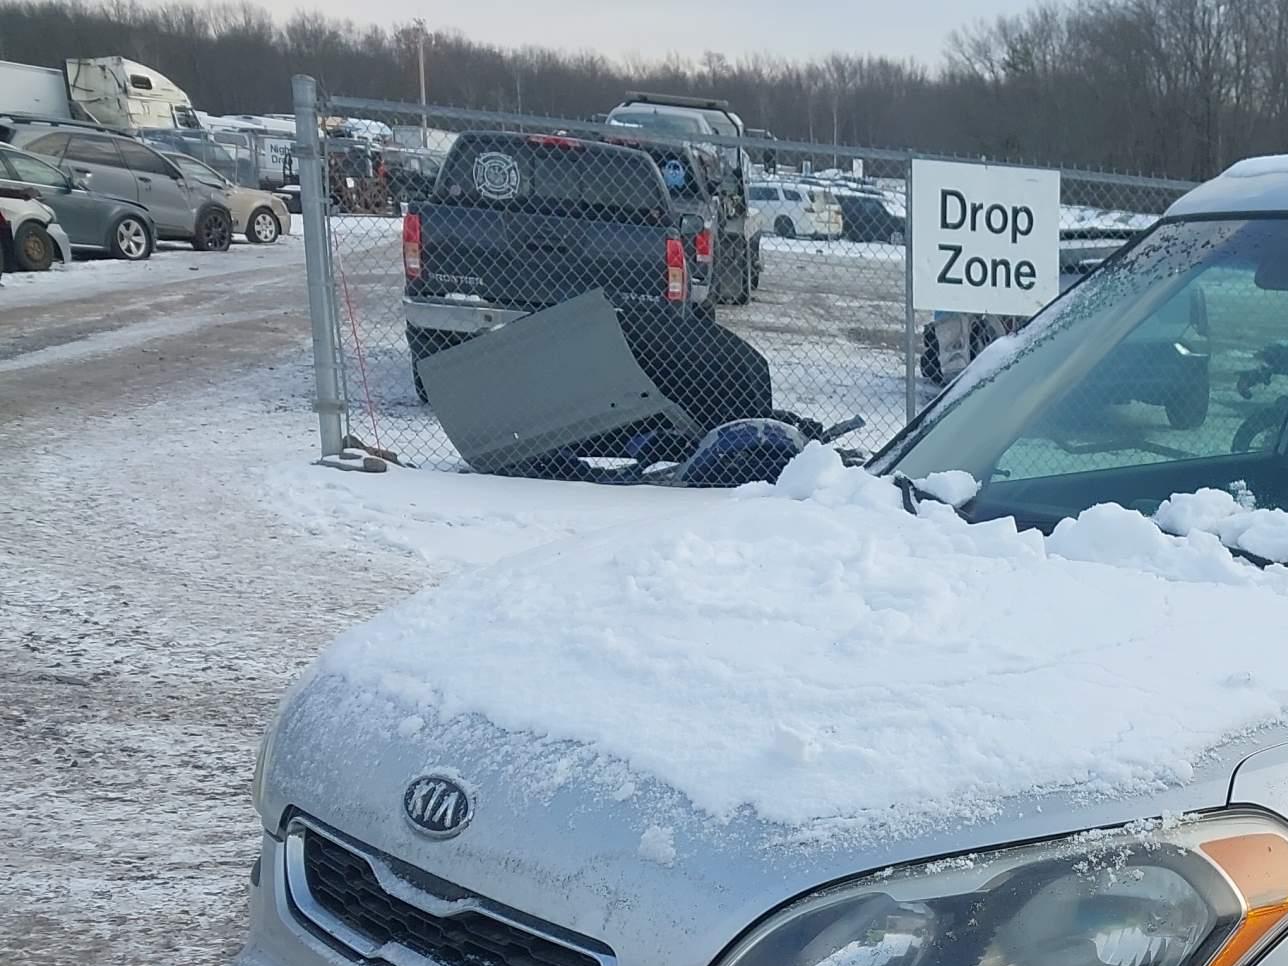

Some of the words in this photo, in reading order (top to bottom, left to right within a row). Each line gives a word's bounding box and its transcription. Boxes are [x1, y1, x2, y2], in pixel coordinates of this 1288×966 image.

[270, 144, 292, 155] Nigh
[940, 188, 1034, 244] Drop
[937, 243, 1037, 291] Zone
[407, 780, 459, 828] KIA
